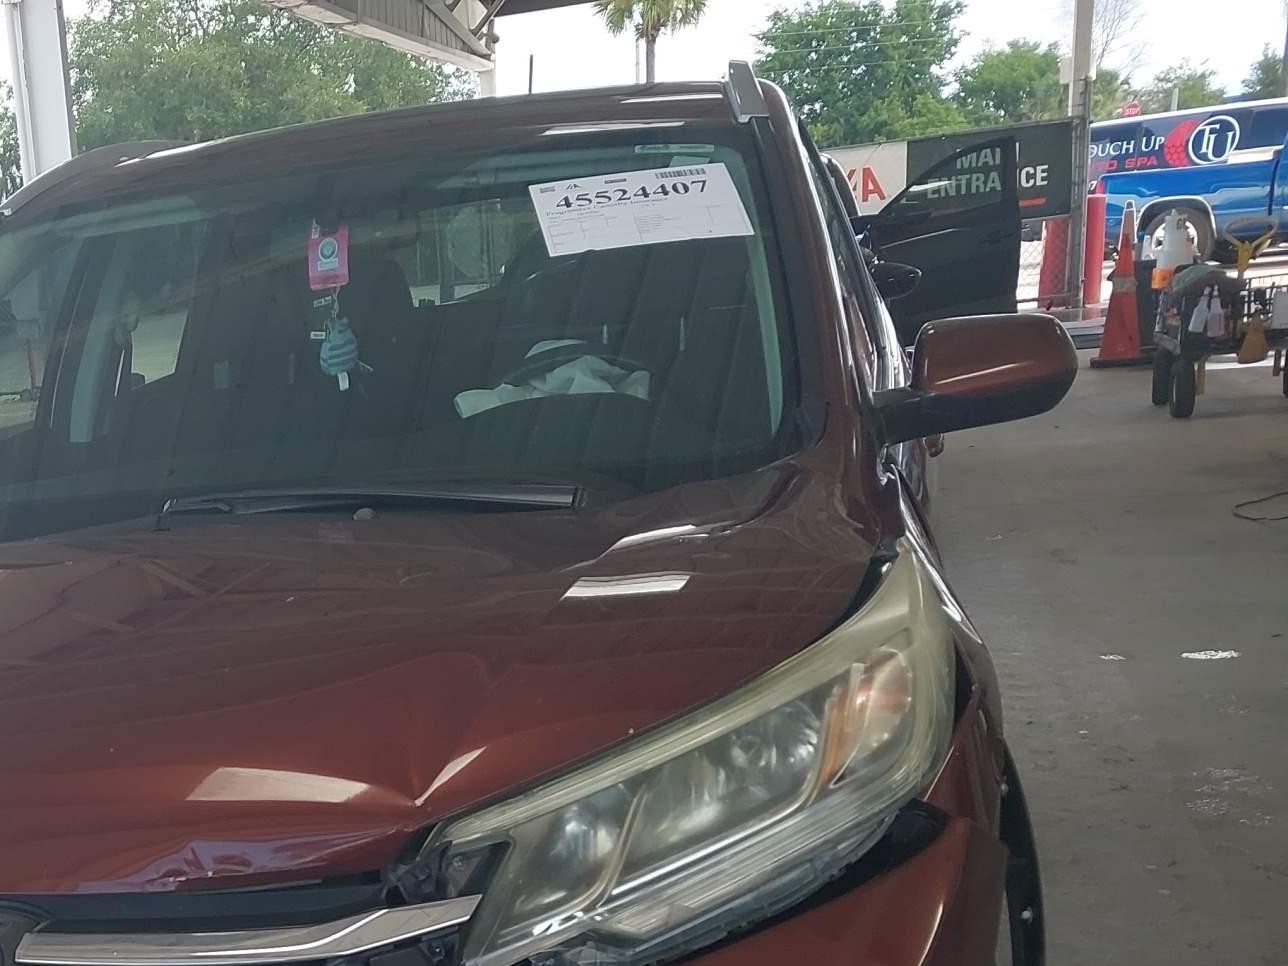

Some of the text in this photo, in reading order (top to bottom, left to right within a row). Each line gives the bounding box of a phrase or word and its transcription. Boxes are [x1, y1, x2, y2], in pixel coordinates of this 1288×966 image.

[956, 141, 1019, 170] MAI
[1142, 136, 1166, 151] UP
[1125, 155, 1158, 169] SPA
[556, 180, 707, 208] 45524407
[927, 164, 1049, 199] ENTRACE
